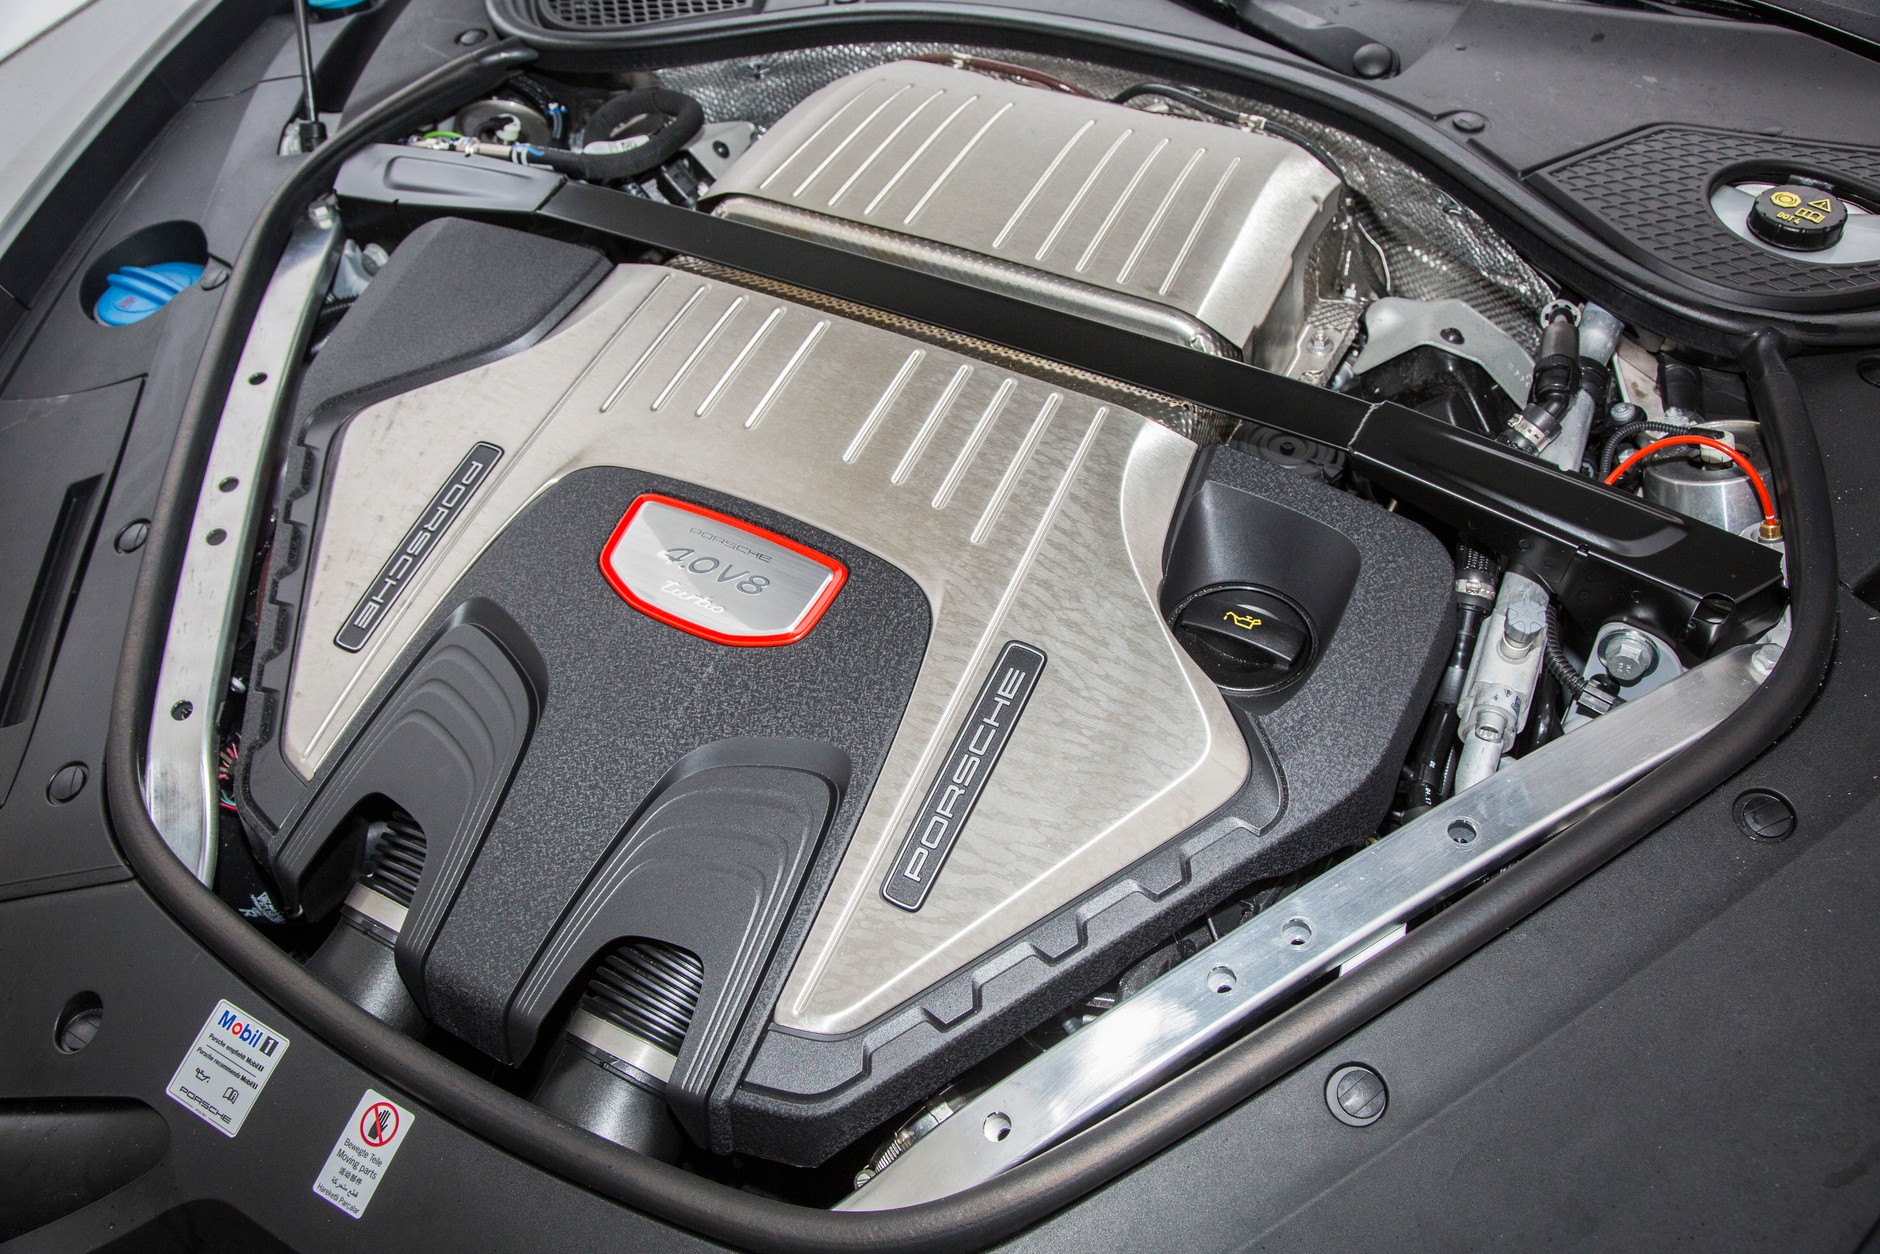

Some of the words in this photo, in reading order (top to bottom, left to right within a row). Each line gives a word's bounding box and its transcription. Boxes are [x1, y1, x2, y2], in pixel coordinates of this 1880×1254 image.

[1776, 211, 1795, 222] DOT
[354, 461, 483, 629] PORSCHE
[688, 527, 773, 563] PORSCHE
[660, 580, 726, 614] turbo
[903, 667, 1026, 883] PORSCHE
[217, 1009, 264, 1048] Mobil
[196, 1046, 214, 1062] Porsche
[213, 1057, 241, 1079] recommends
[241, 1074, 254, 1088] Mobil
[208, 1032, 226, 1048] Porsche
[225, 1043, 247, 1061] empfiehlt
[246, 1057, 260, 1071] Mobil
[179, 1085, 232, 1125] PORSCHE
[336, 1148, 360, 1171] Moving
[359, 1164, 378, 1180] parts
[343, 1137, 369, 1159] Bewegte
[369, 1153, 383, 1168] Teile
[316, 1182, 340, 1202] Hareketli
[339, 1196, 360, 1215] Parçalar
